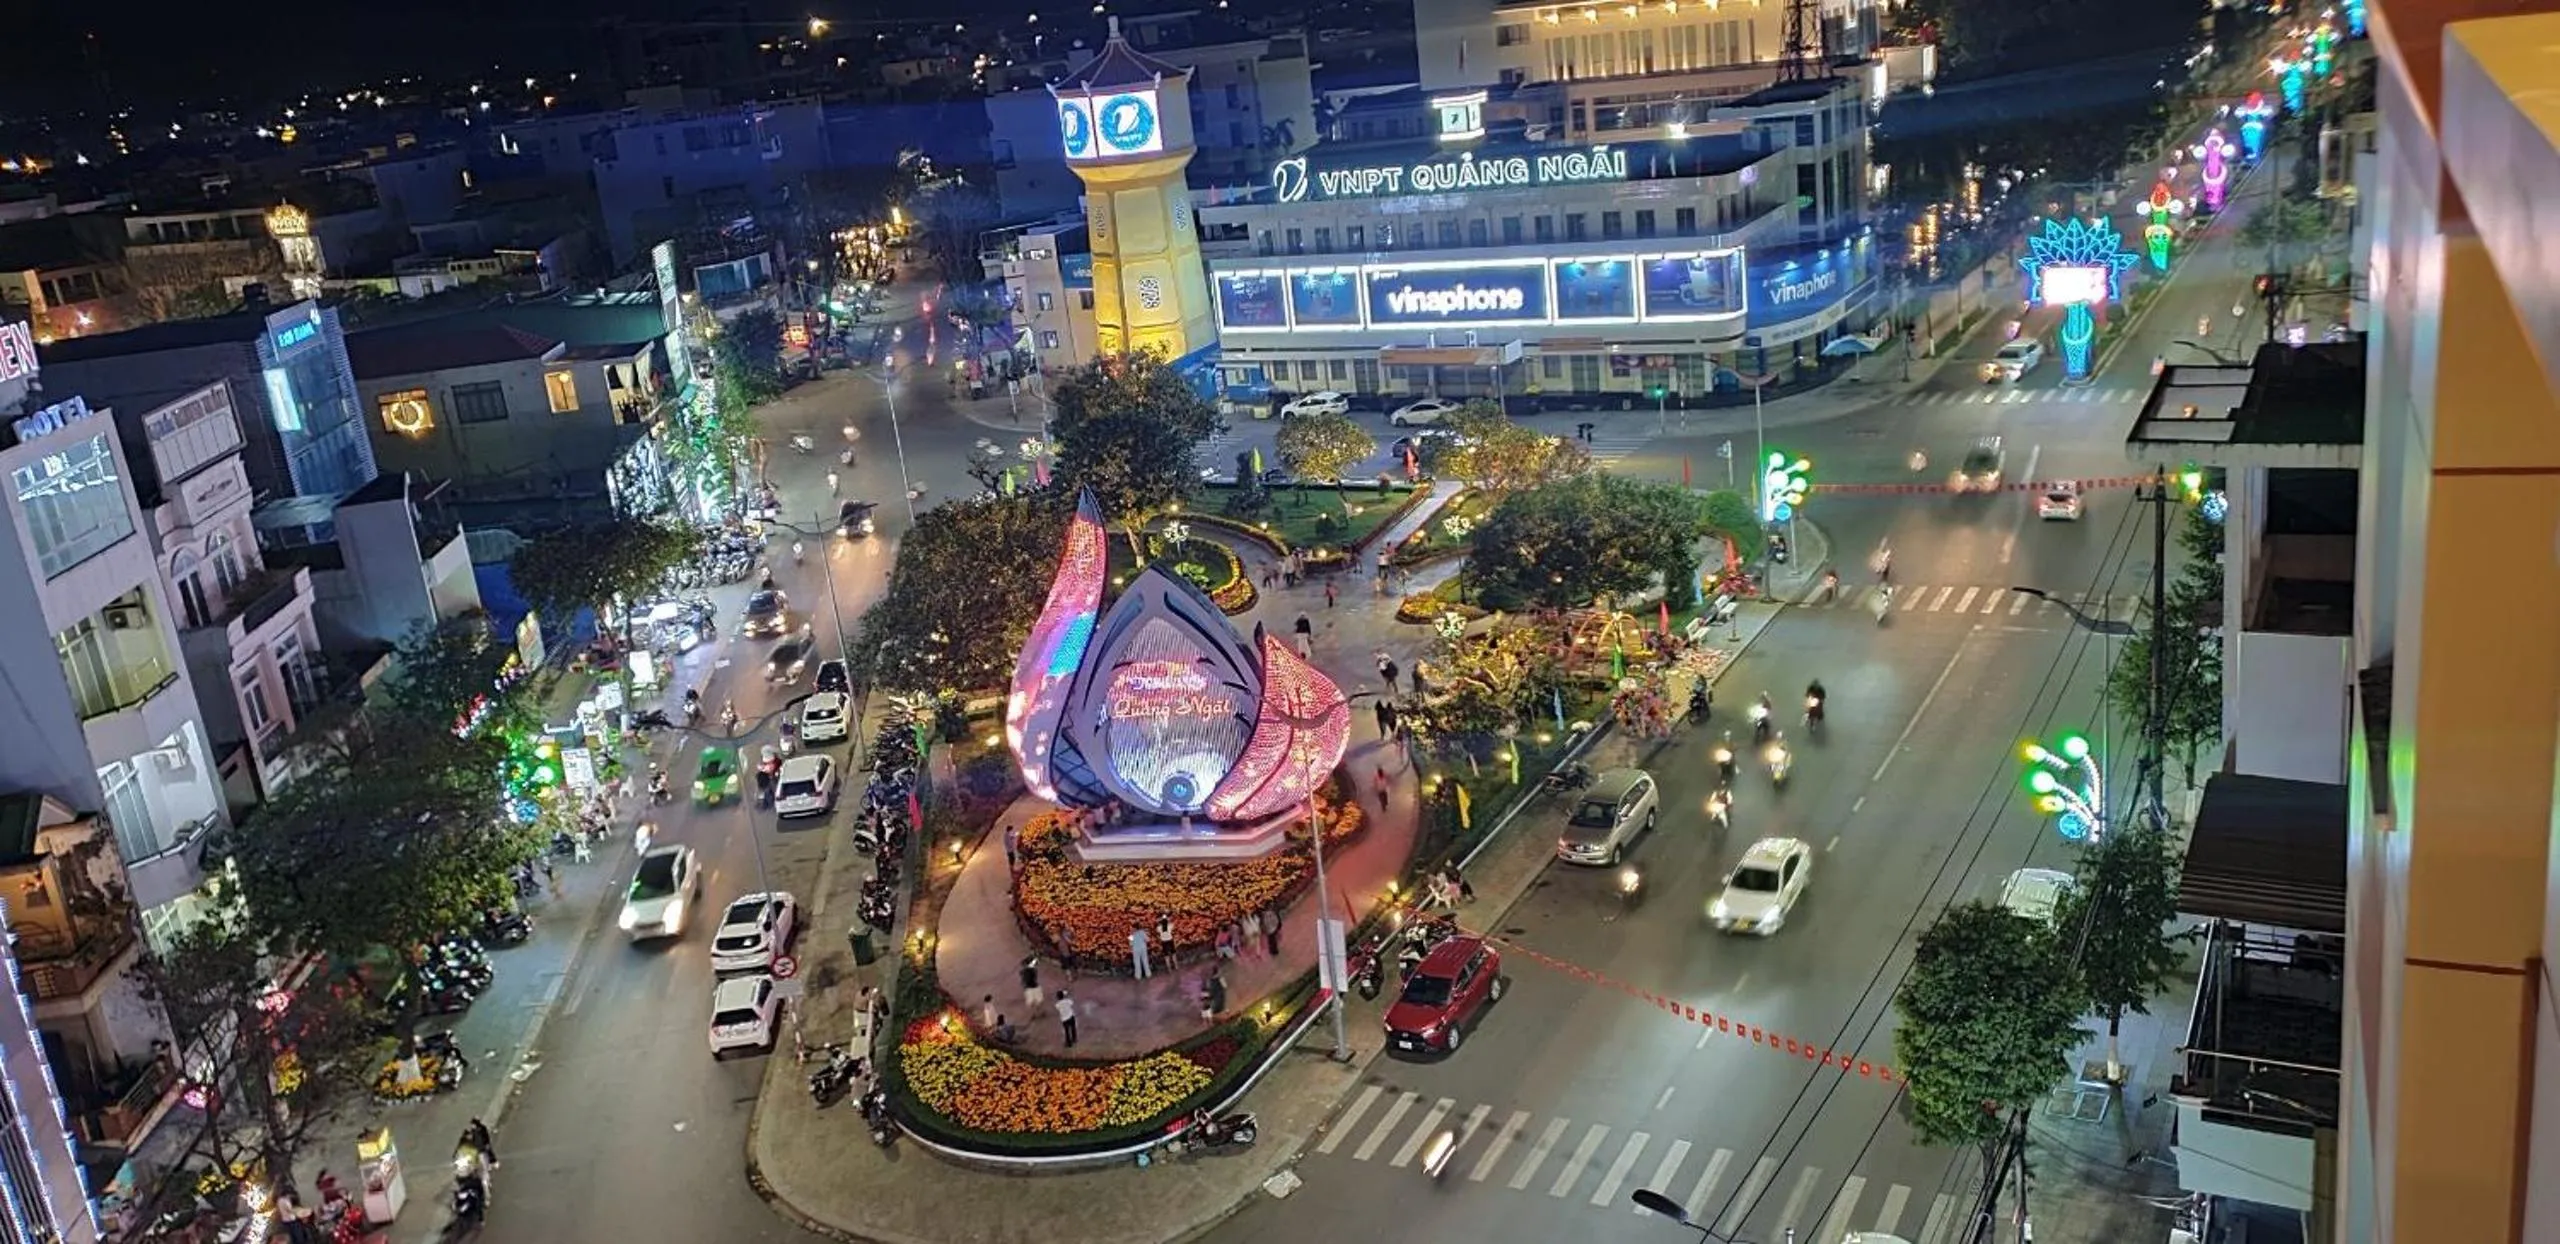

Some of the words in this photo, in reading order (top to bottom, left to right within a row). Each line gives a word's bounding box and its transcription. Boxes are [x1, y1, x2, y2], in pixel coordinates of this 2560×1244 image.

[1319, 166, 1403, 195] VNPT
[1411, 152, 1530, 192] QUẢNG
[1537, 146, 1627, 181] NGÃI
[1388, 283, 1524, 316] vinaphone
[1769, 269, 1837, 305] vinaphone
[0, 320, 39, 382] EN
